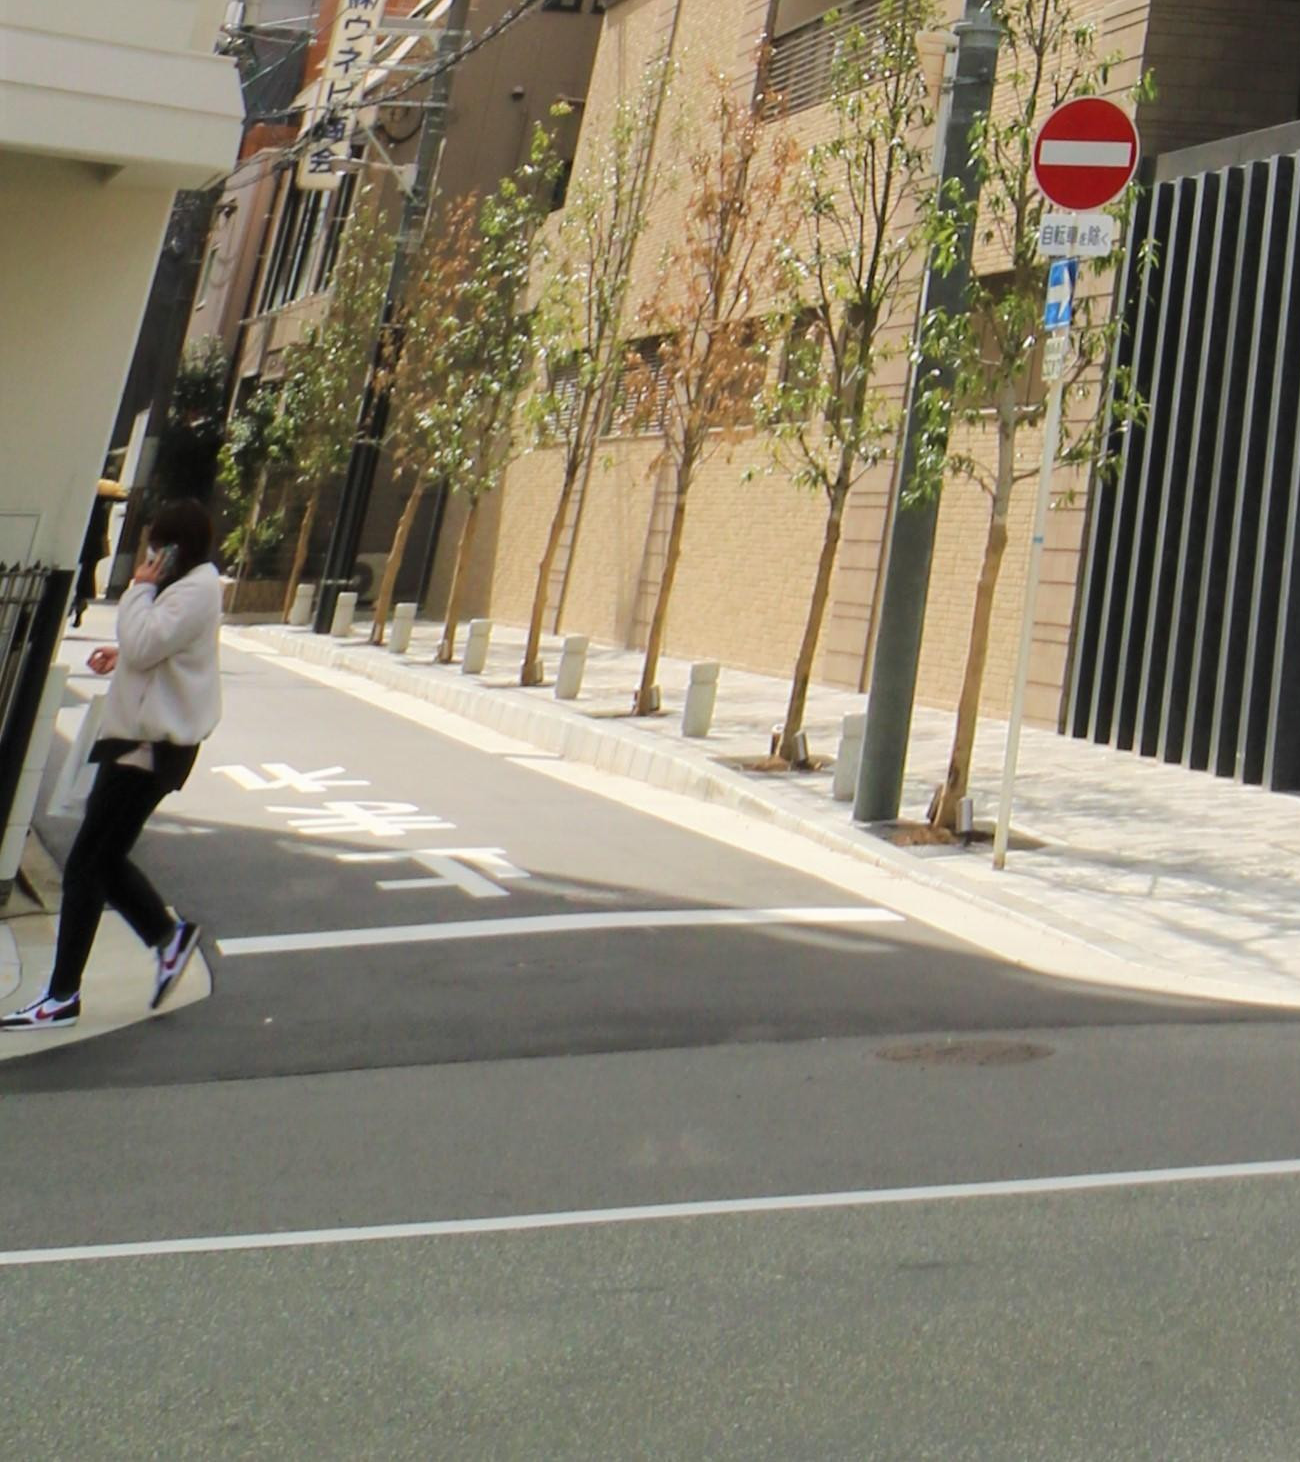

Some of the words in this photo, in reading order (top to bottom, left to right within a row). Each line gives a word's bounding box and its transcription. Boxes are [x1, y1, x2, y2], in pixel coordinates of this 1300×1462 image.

[1041, 224, 1110, 247] 自転車を除く
